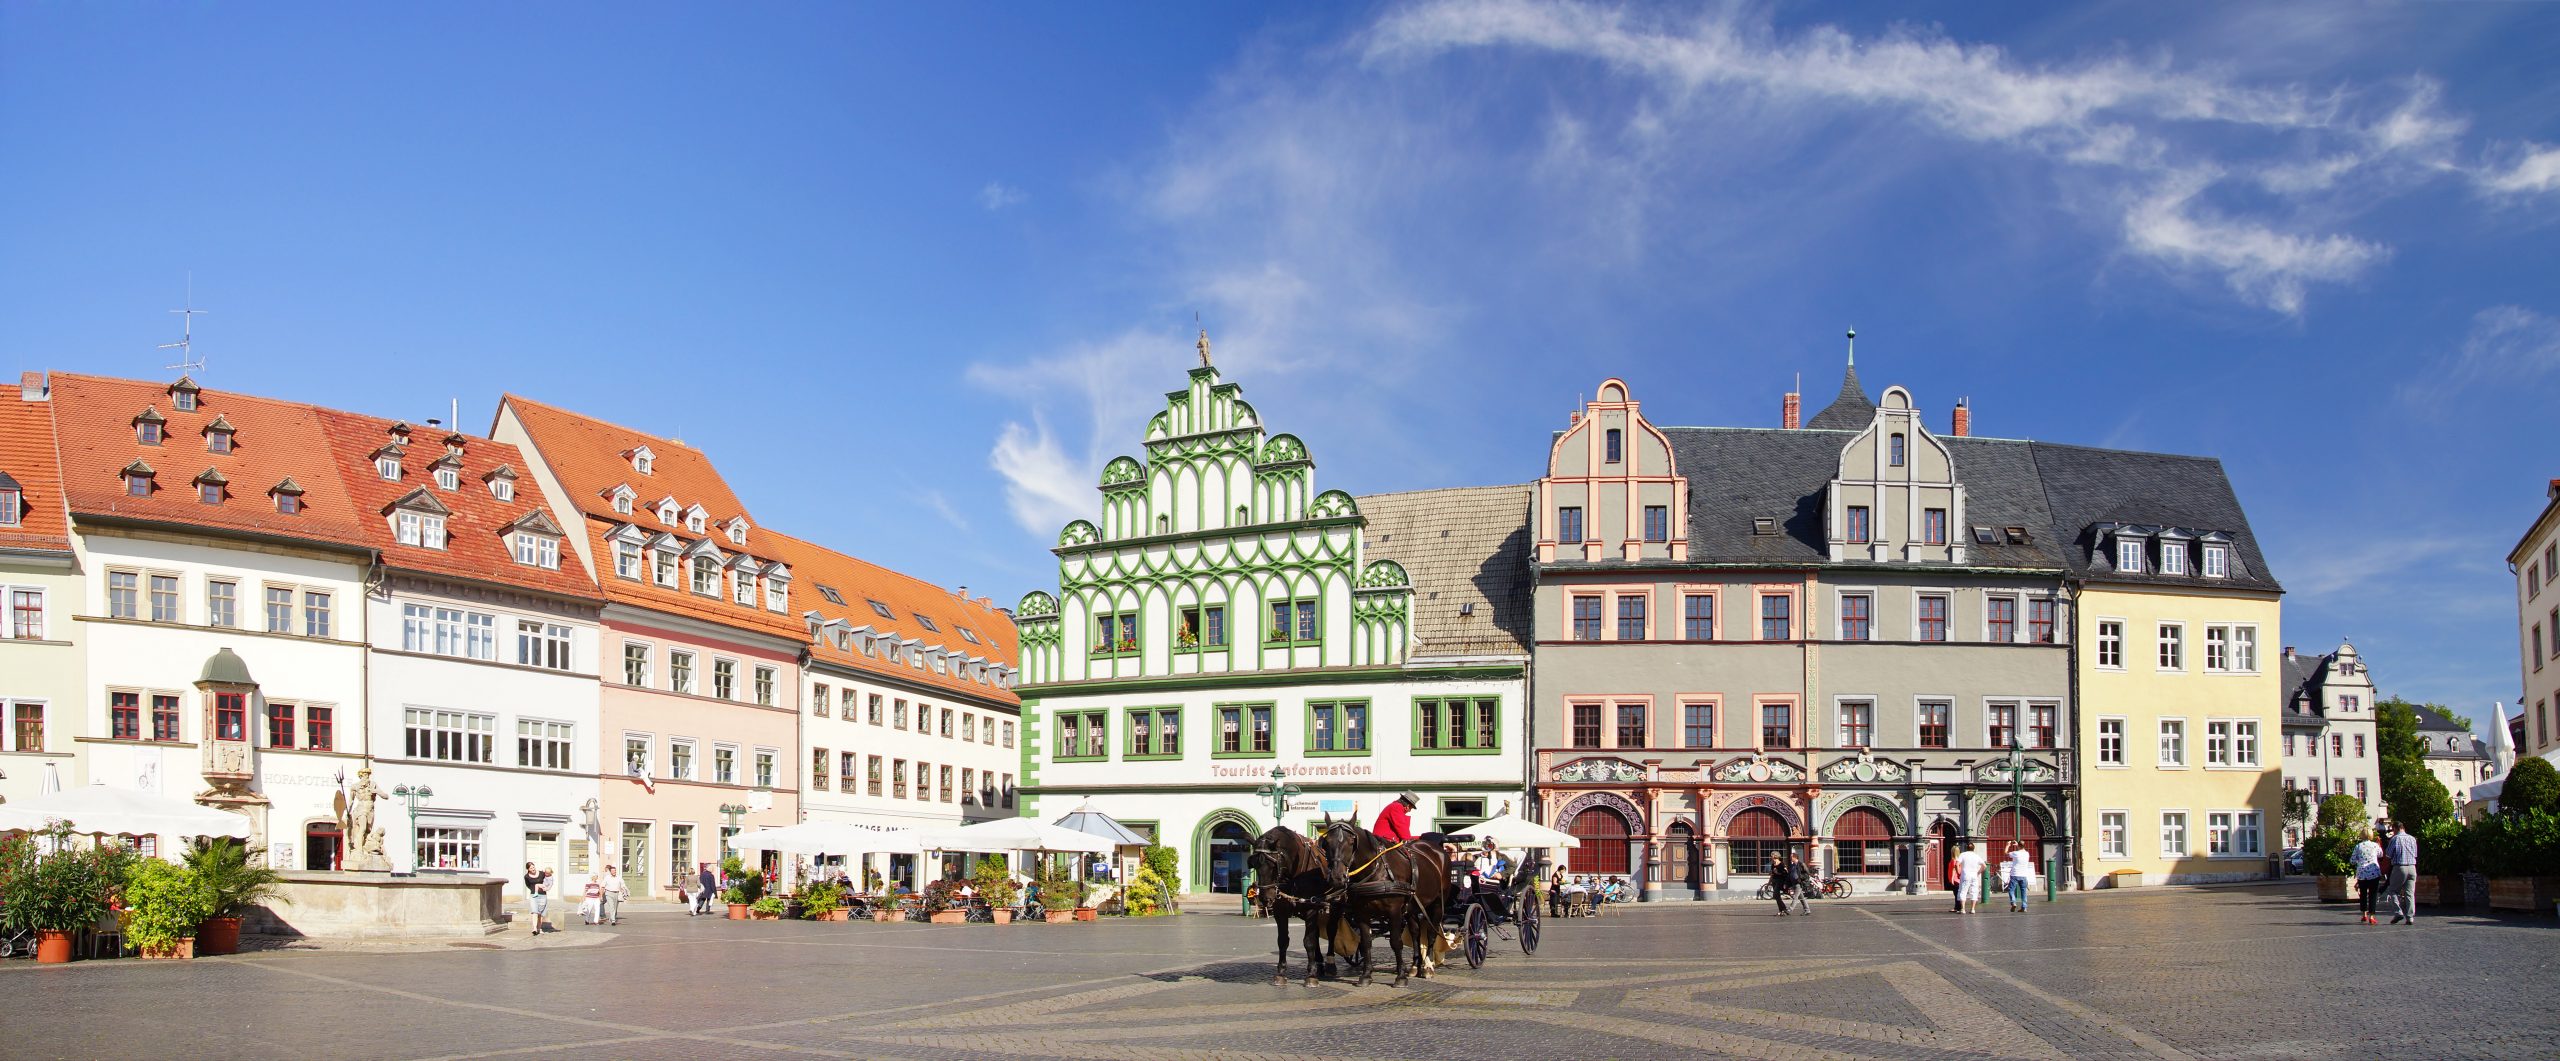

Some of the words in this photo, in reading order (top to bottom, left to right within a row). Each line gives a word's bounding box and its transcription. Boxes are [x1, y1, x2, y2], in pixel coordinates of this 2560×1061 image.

[1211, 764, 1266, 777] Tourist
[1279, 763, 1372, 776] nformation
[264, 773, 353, 788] HOFAPOTHEE
